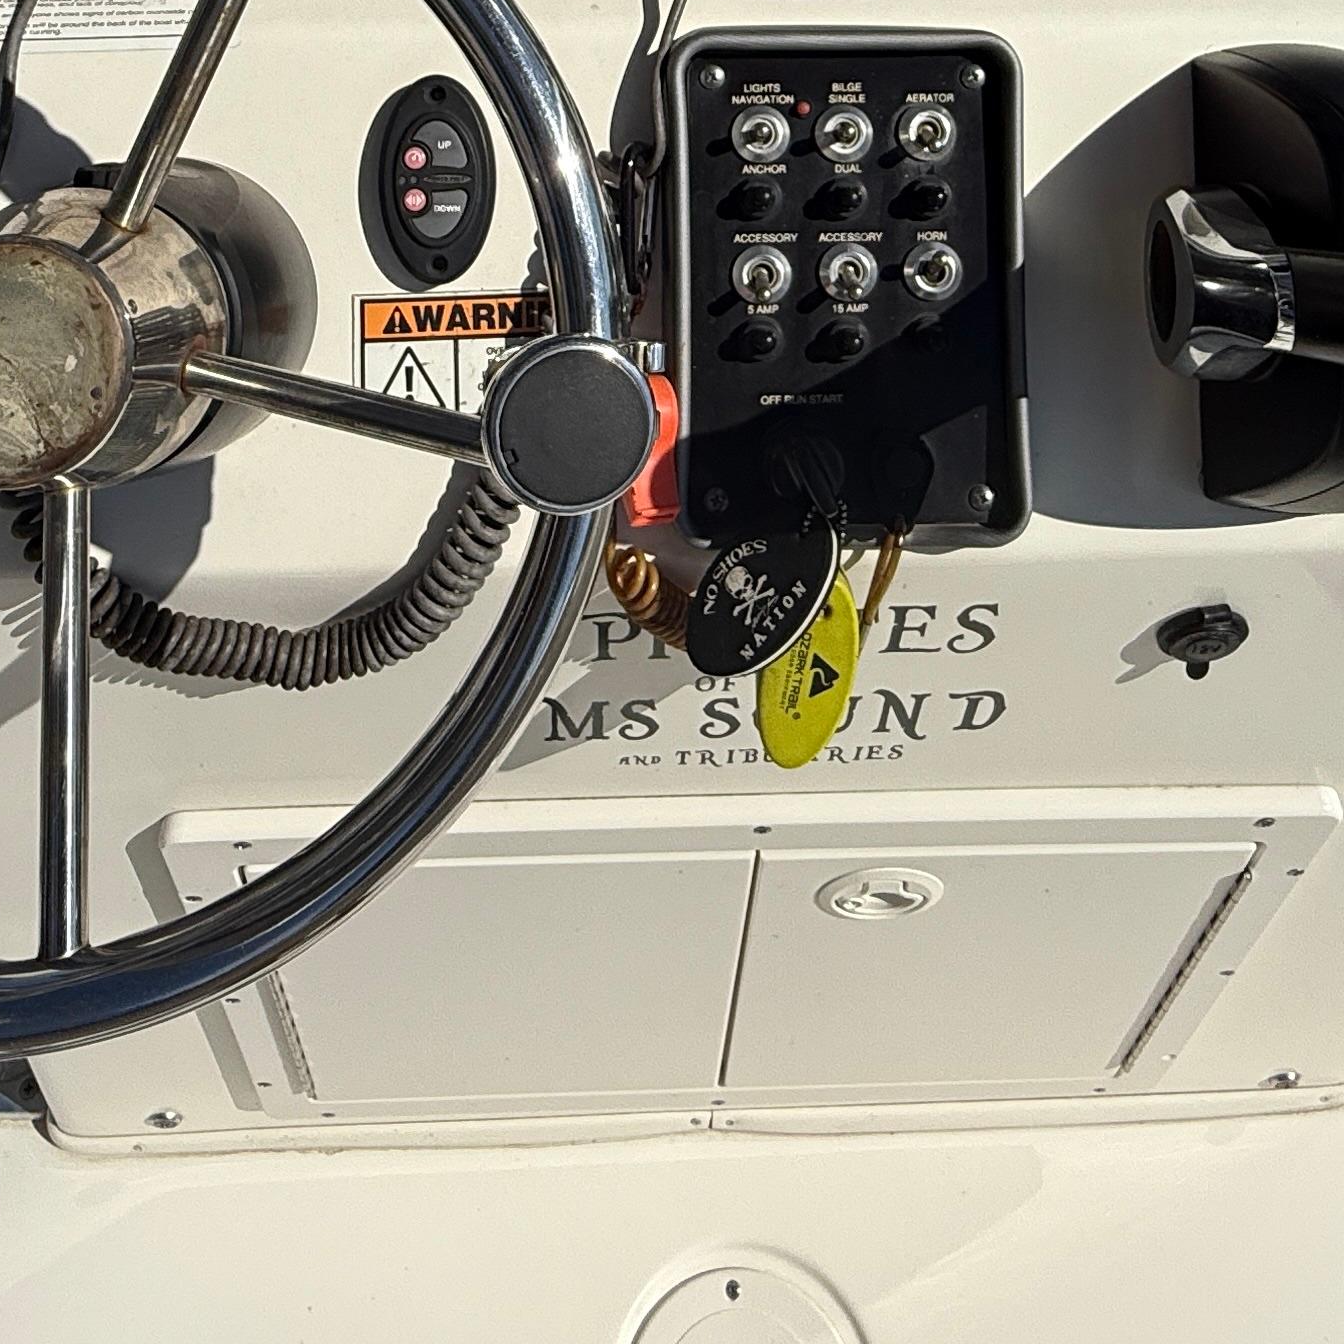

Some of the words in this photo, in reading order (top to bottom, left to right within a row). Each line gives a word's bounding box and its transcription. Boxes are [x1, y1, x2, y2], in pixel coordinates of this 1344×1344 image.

[744, 83, 781, 93] LIGHTS
[832, 82, 863, 93] BILGE
[732, 94, 794, 105] NAVIGATION
[828, 93, 866, 104] SINGLE
[905, 92, 955, 103] AERATOR
[437, 140, 452, 149] UP
[742, 164, 787, 174] ANCHOR
[835, 164, 862, 174] DUAL
[433, 204, 461, 213] DOWN
[733, 232, 798, 243] ACCESSORY
[818, 232, 884, 243] ACCESSORY
[917, 231, 948, 242] HORN
[747, 304, 755, 315] 5
[755, 304, 779, 315] AMP
[832, 303, 844, 314] 15
[846, 302, 869, 314] AMP
[760, 395, 782, 406] OFF
[784, 394, 807, 405] RUN
[703, 584, 719, 616] NO
[712, 539, 768, 584] SHOES
[739, 580, 807, 661] NATION
[695, 675, 736, 692] OF
[542, 696, 660, 741] MS
[619, 755, 661, 765] AND
